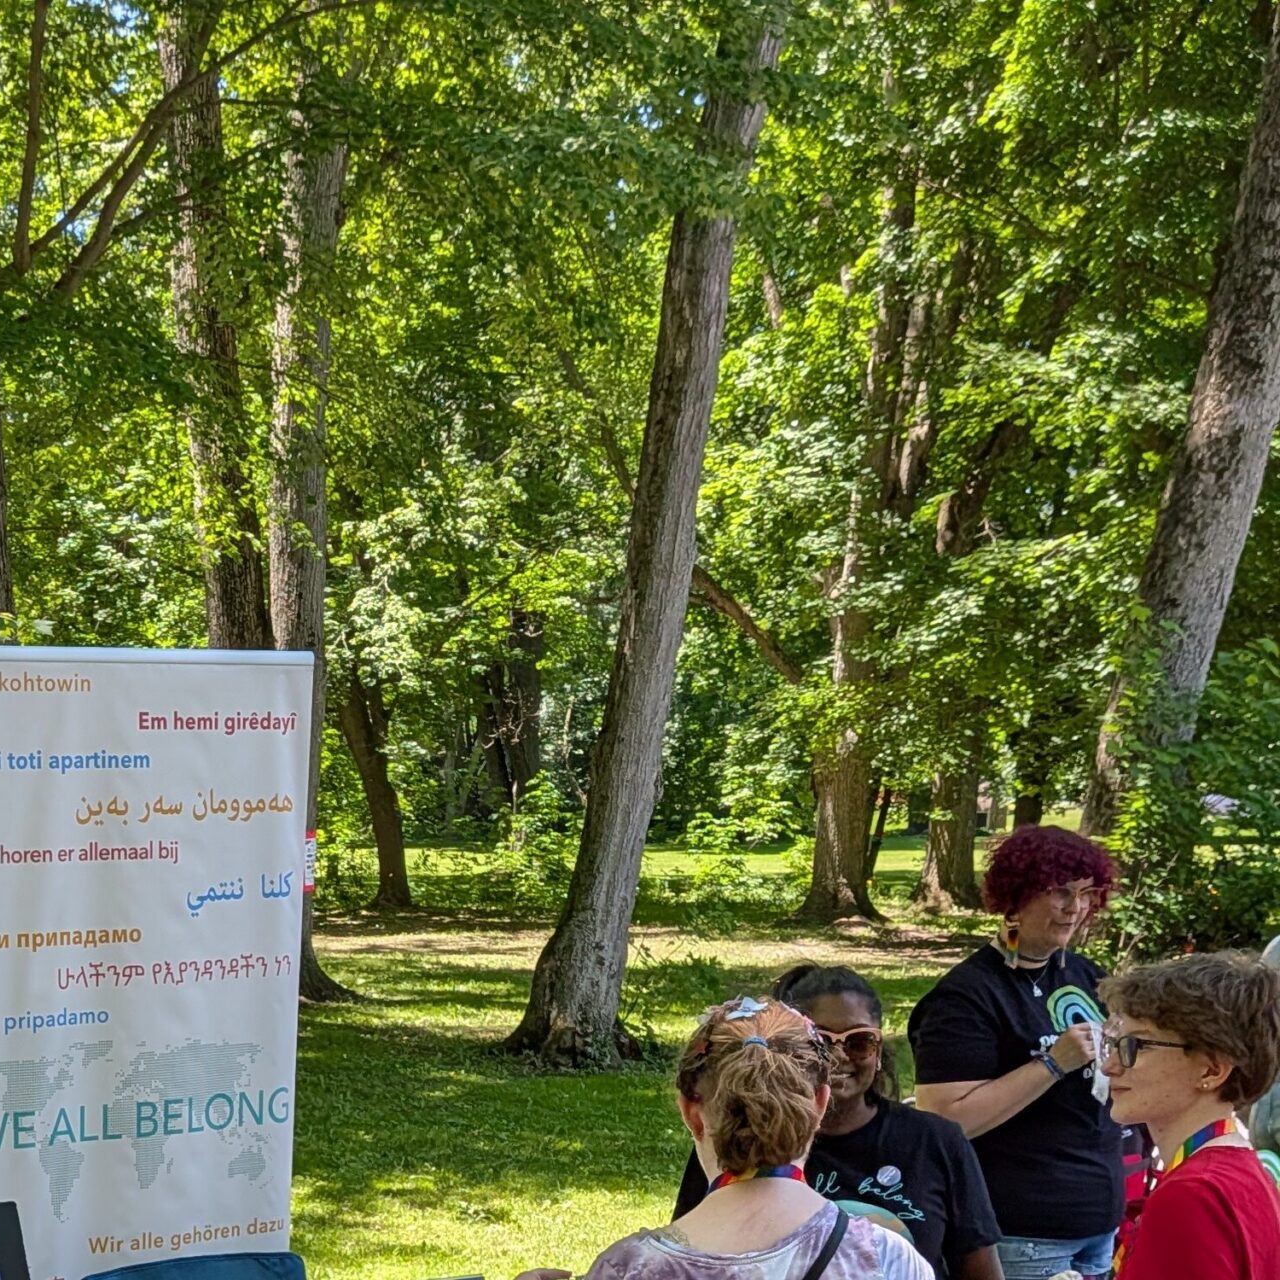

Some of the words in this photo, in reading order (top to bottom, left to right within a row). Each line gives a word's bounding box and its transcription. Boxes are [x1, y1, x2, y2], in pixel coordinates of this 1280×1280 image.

[138, 711, 168, 731] Em
[174, 710, 219, 731] hemi
[7, 750, 42, 770] toti
[49, 750, 151, 775] apartinem
[0, 844, 53, 864] horen
[58, 848, 75, 863] er
[78, 841, 153, 862] allemaal
[158, 840, 179, 865] bij
[17, 928, 142, 952] припадамо
[4, 1009, 109, 1035] pripadamo
[49, 1104, 122, 1147] ALL
[135, 1087, 289, 1138] BELONG
[858, 1177, 926, 1221] belong
[89, 1235, 122, 1254] Wir
[130, 1232, 164, 1251] alle
[170, 1225, 240, 1253] gehören
[247, 1218, 284, 1236] dazu
